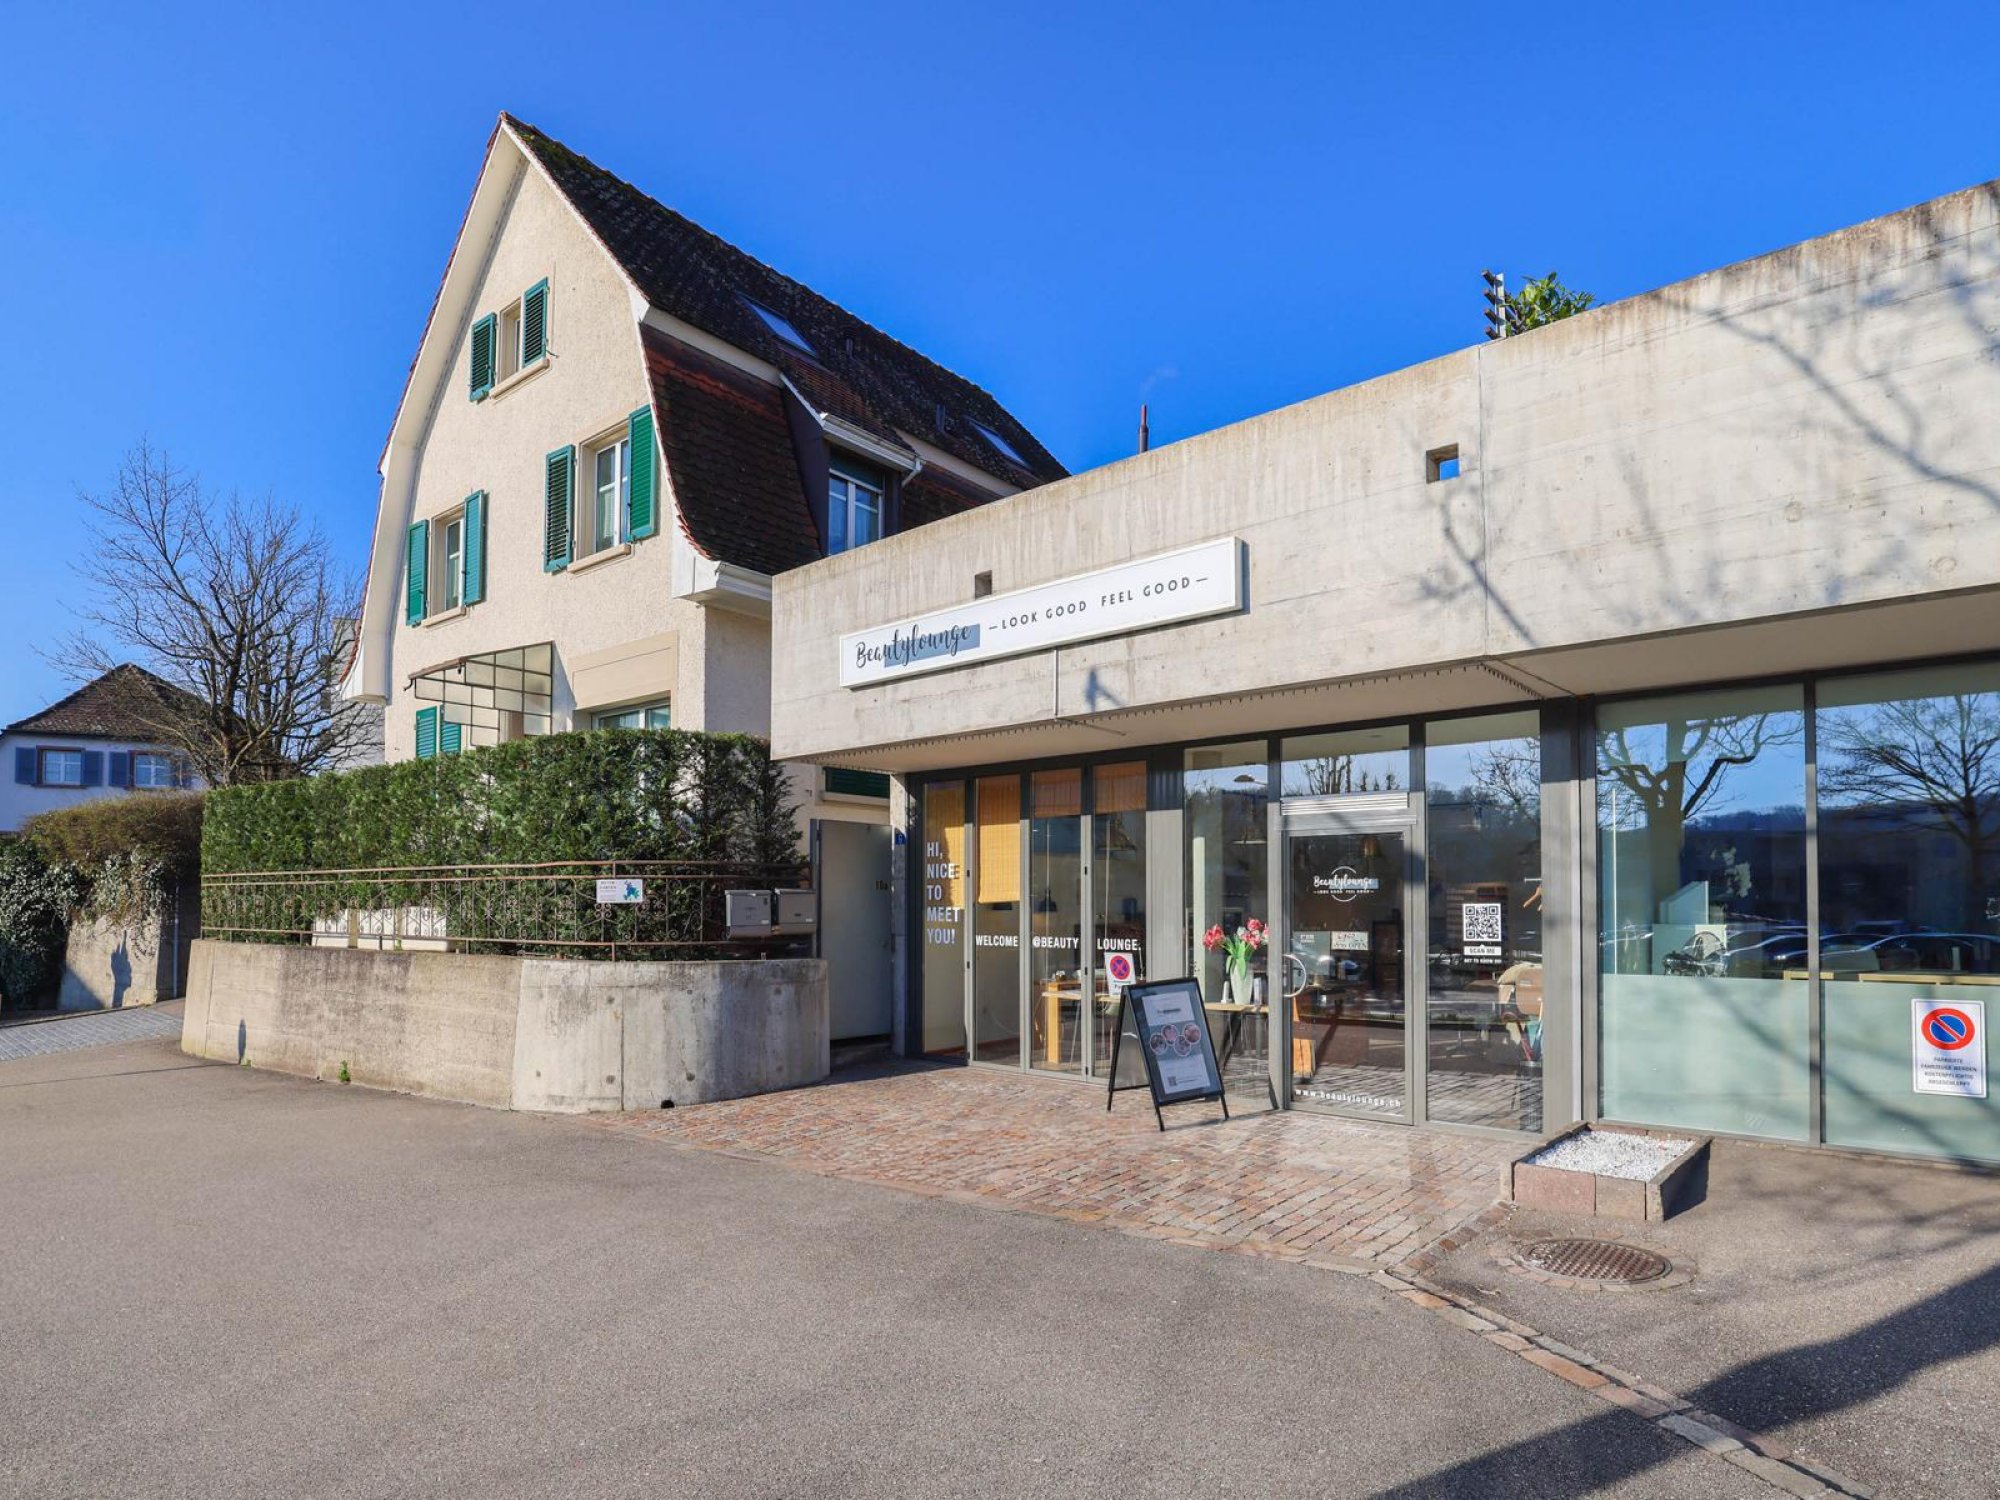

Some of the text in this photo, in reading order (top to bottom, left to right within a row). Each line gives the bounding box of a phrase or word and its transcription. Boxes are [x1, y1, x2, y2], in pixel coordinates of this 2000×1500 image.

[856, 624, 972, 668] Beautylounge
[1045, 600, 1087, 619] GOOD
[1101, 590, 1133, 607] FEEL
[927, 841, 943, 859] HI,
[927, 863, 955, 879] NICE
[1313, 874, 1373, 890] Beautylounge
[927, 885, 943, 900] TO
[927, 906, 960, 922] MEET
[927, 928, 956, 944] YOU!
[976, 935, 1142, 950] WELCOME @BEAUTY LOUNGE.
